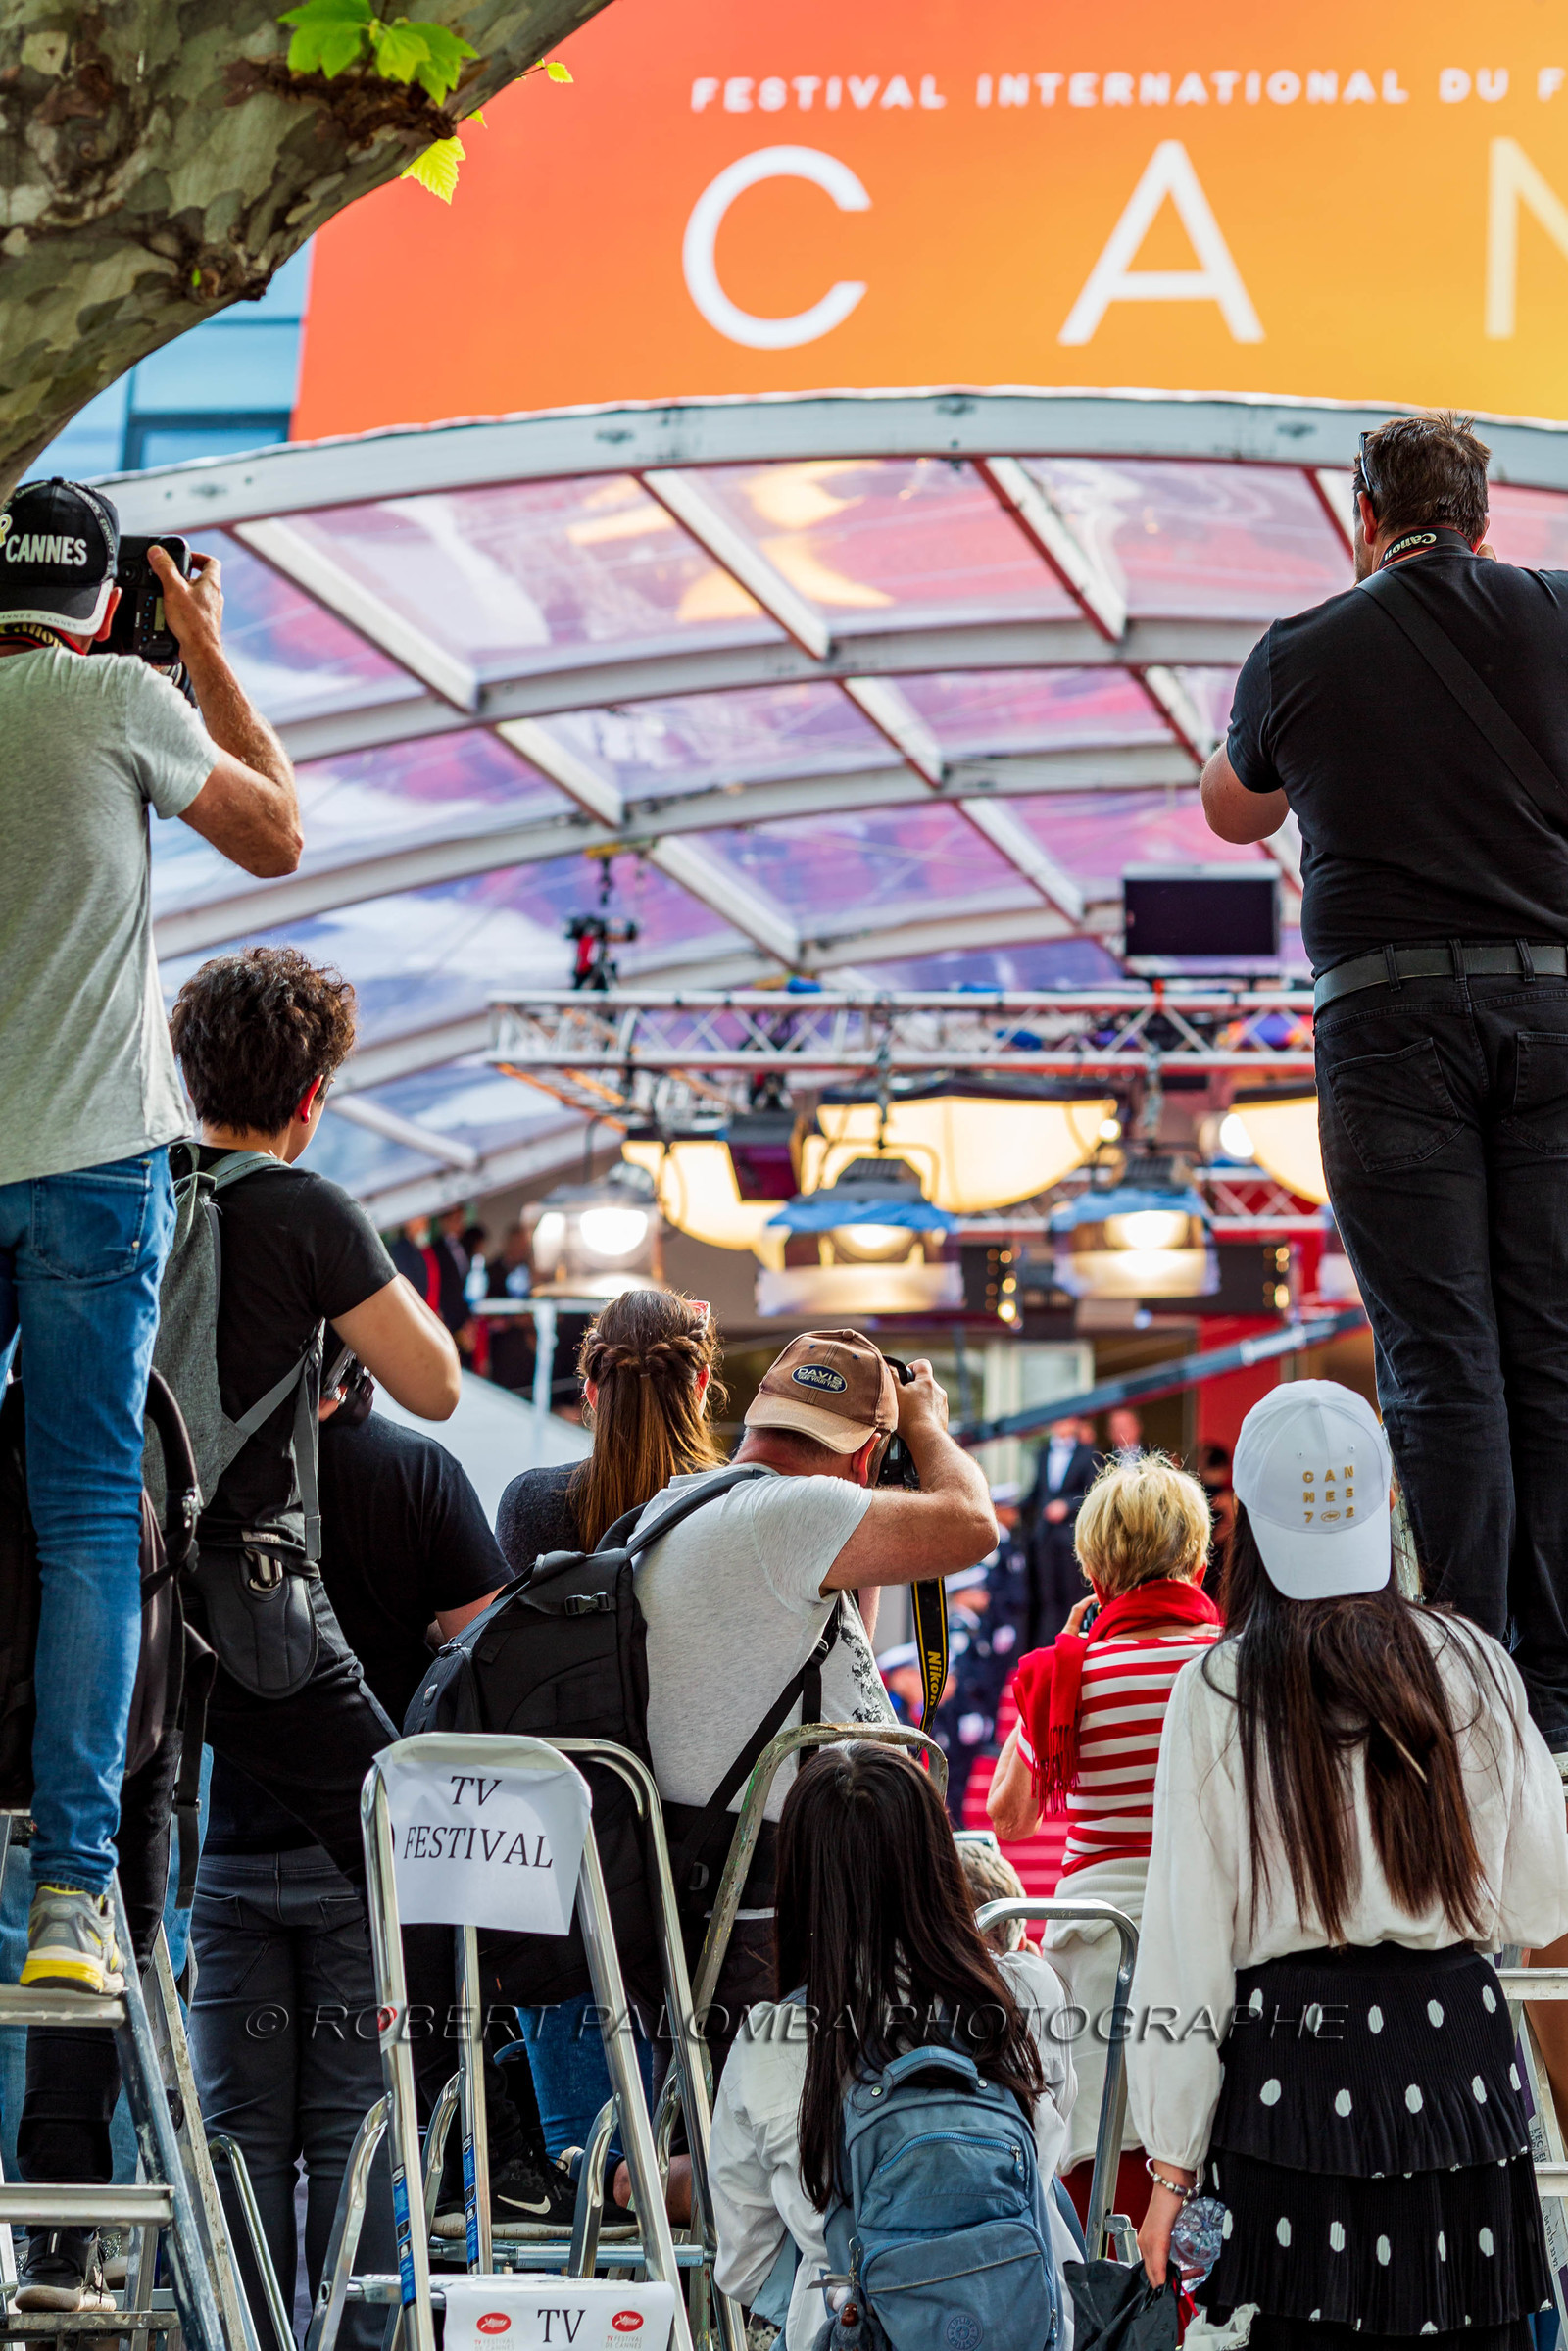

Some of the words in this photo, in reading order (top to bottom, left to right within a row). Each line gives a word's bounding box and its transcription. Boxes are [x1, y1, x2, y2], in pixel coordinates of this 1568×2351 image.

[690, 74, 948, 113] FESTIVAL
[975, 69, 1409, 109] INTERNATIONAL
[1439, 67, 1510, 104] DU
[1537, 66, 1566, 103] F
[5, 533, 87, 566] CANNES
[1384, 532, 1437, 562] Canon
[797, 1368, 842, 1385] DAVIS
[927, 1650, 942, 1706] Nikon
[450, 1775, 502, 1807] TV
[403, 1826, 553, 1869] FESTIVAL
[537, 2308, 586, 2343] TV
